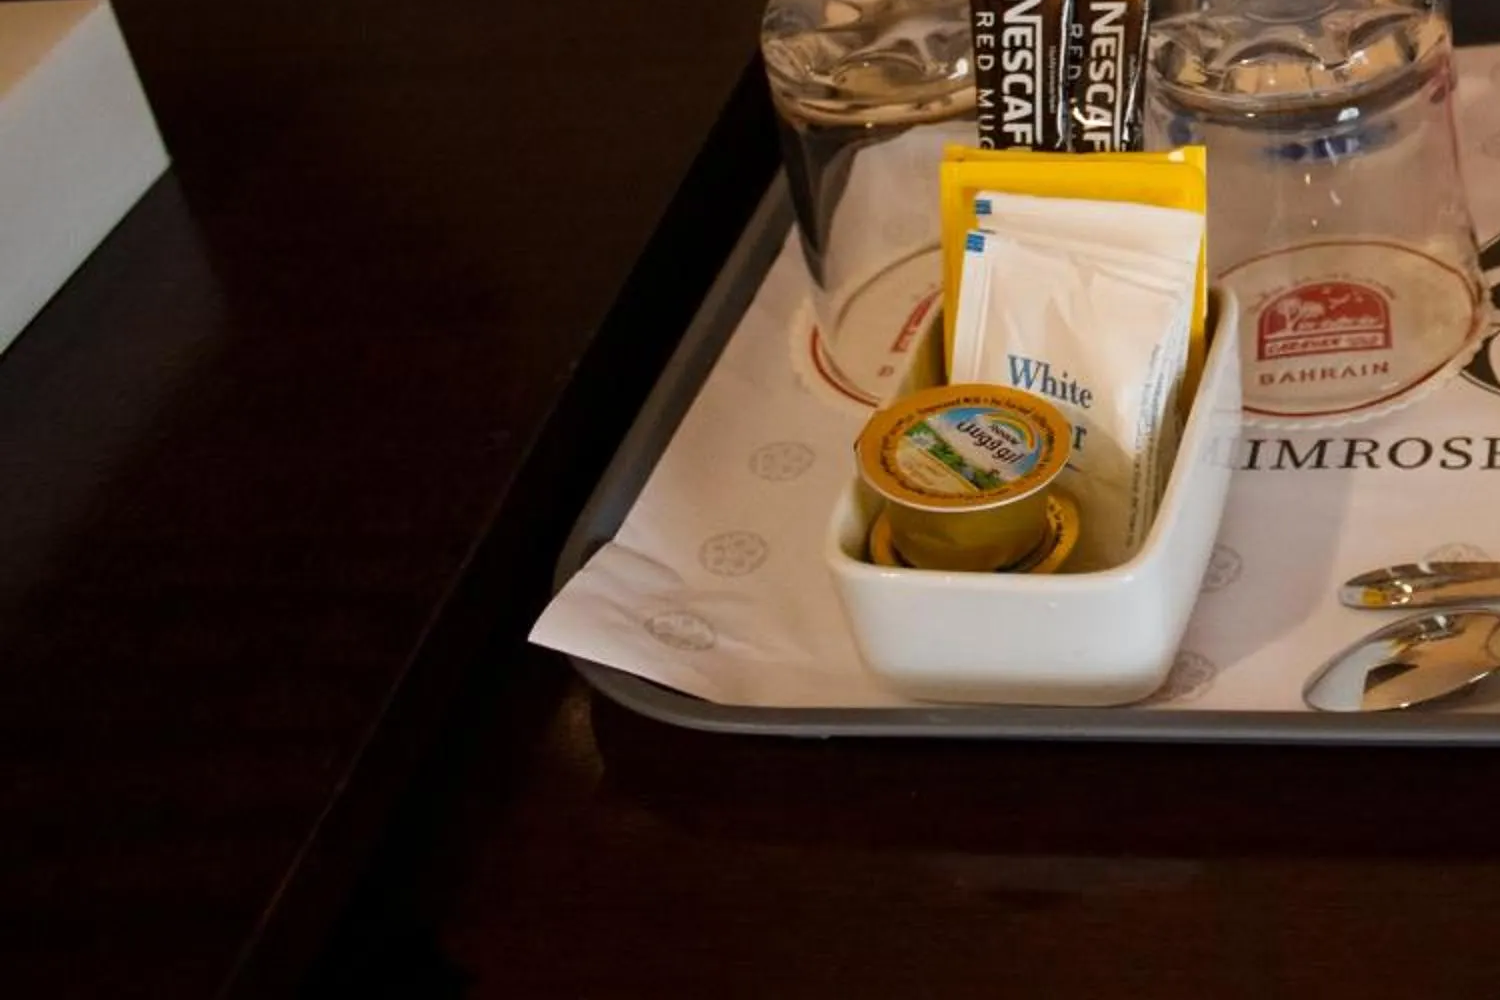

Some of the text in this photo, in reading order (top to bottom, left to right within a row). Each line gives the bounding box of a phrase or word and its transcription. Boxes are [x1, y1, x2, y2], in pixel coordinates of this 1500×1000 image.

[975, 11, 995, 71] RED
[1083, 1, 1127, 152] NESCAF
[1007, 354, 1094, 409] White
[1259, 361, 1390, 386] BAHRAIN
